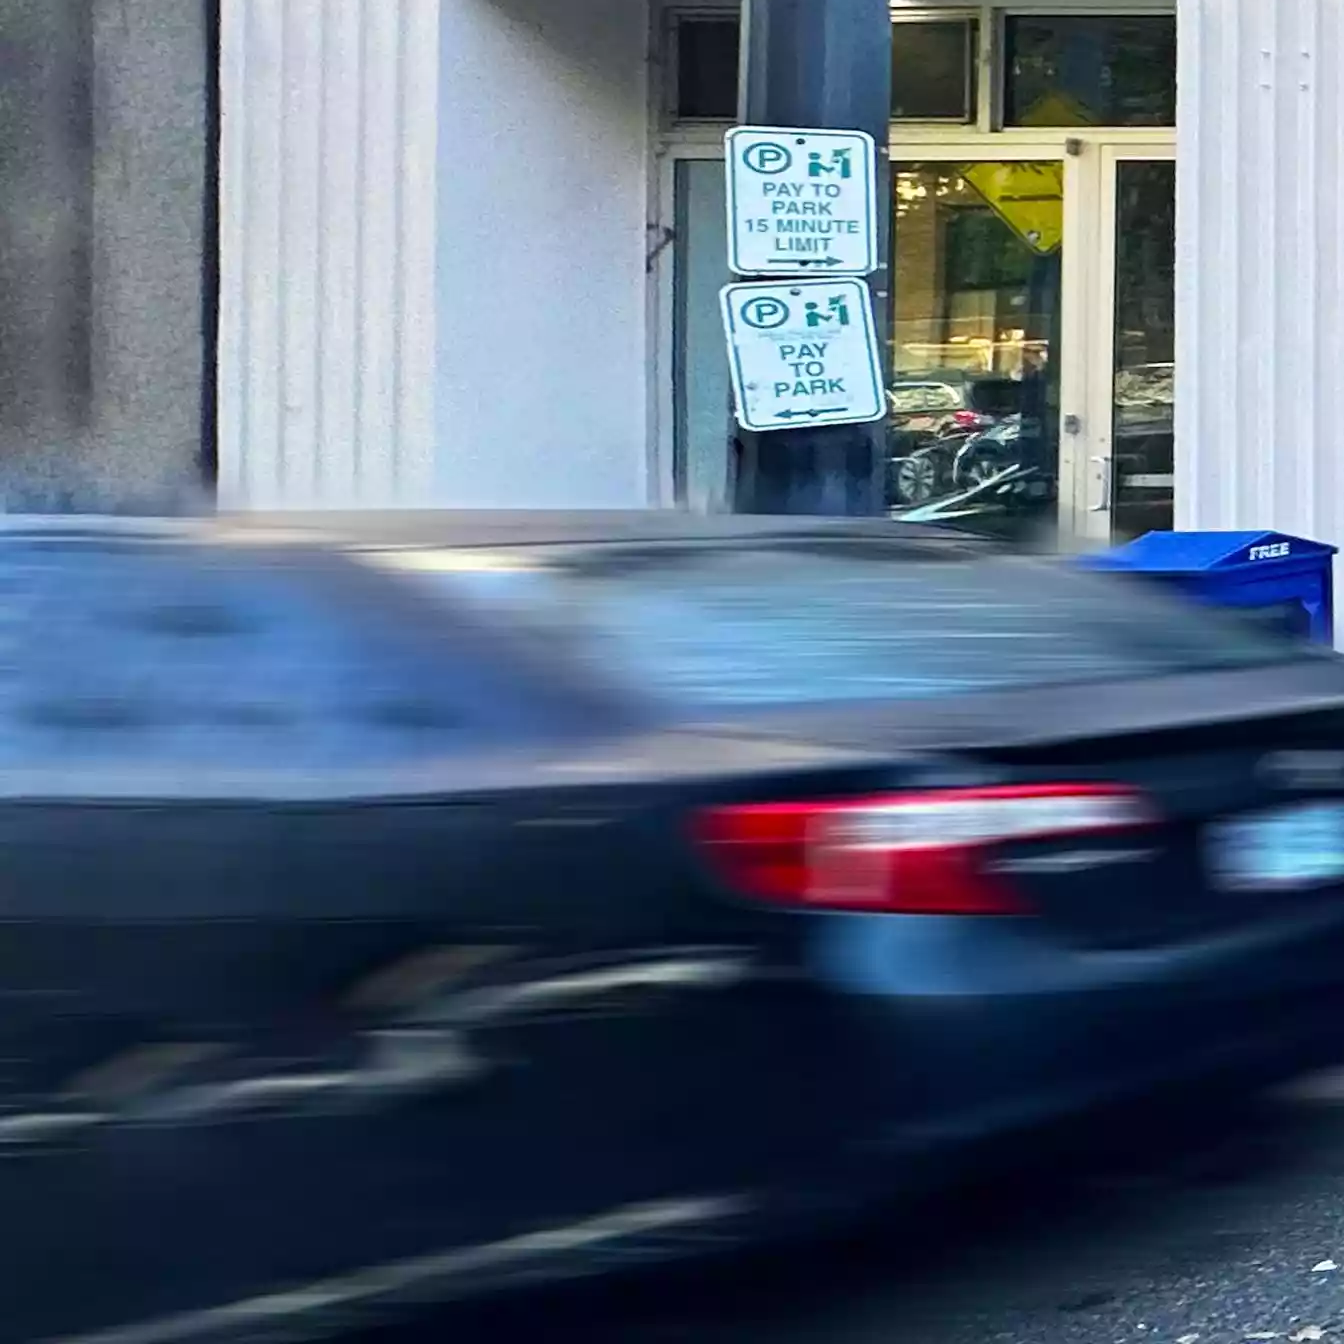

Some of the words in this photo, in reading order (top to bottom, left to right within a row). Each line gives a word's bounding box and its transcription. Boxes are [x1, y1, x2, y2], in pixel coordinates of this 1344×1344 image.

[758, 149, 782, 168] P
[763, 182, 804, 197] PAY
[811, 183, 840, 198] TO
[772, 200, 833, 216] PARK
[744, 218, 769, 233] 15
[776, 219, 860, 234] MINUTE
[775, 237, 834, 253] LIMIT
[755, 303, 778, 323] P
[779, 342, 829, 361] PAY
[788, 361, 824, 377] TO
[774, 377, 846, 397] PARK
[1250, 542, 1290, 561] FREE
